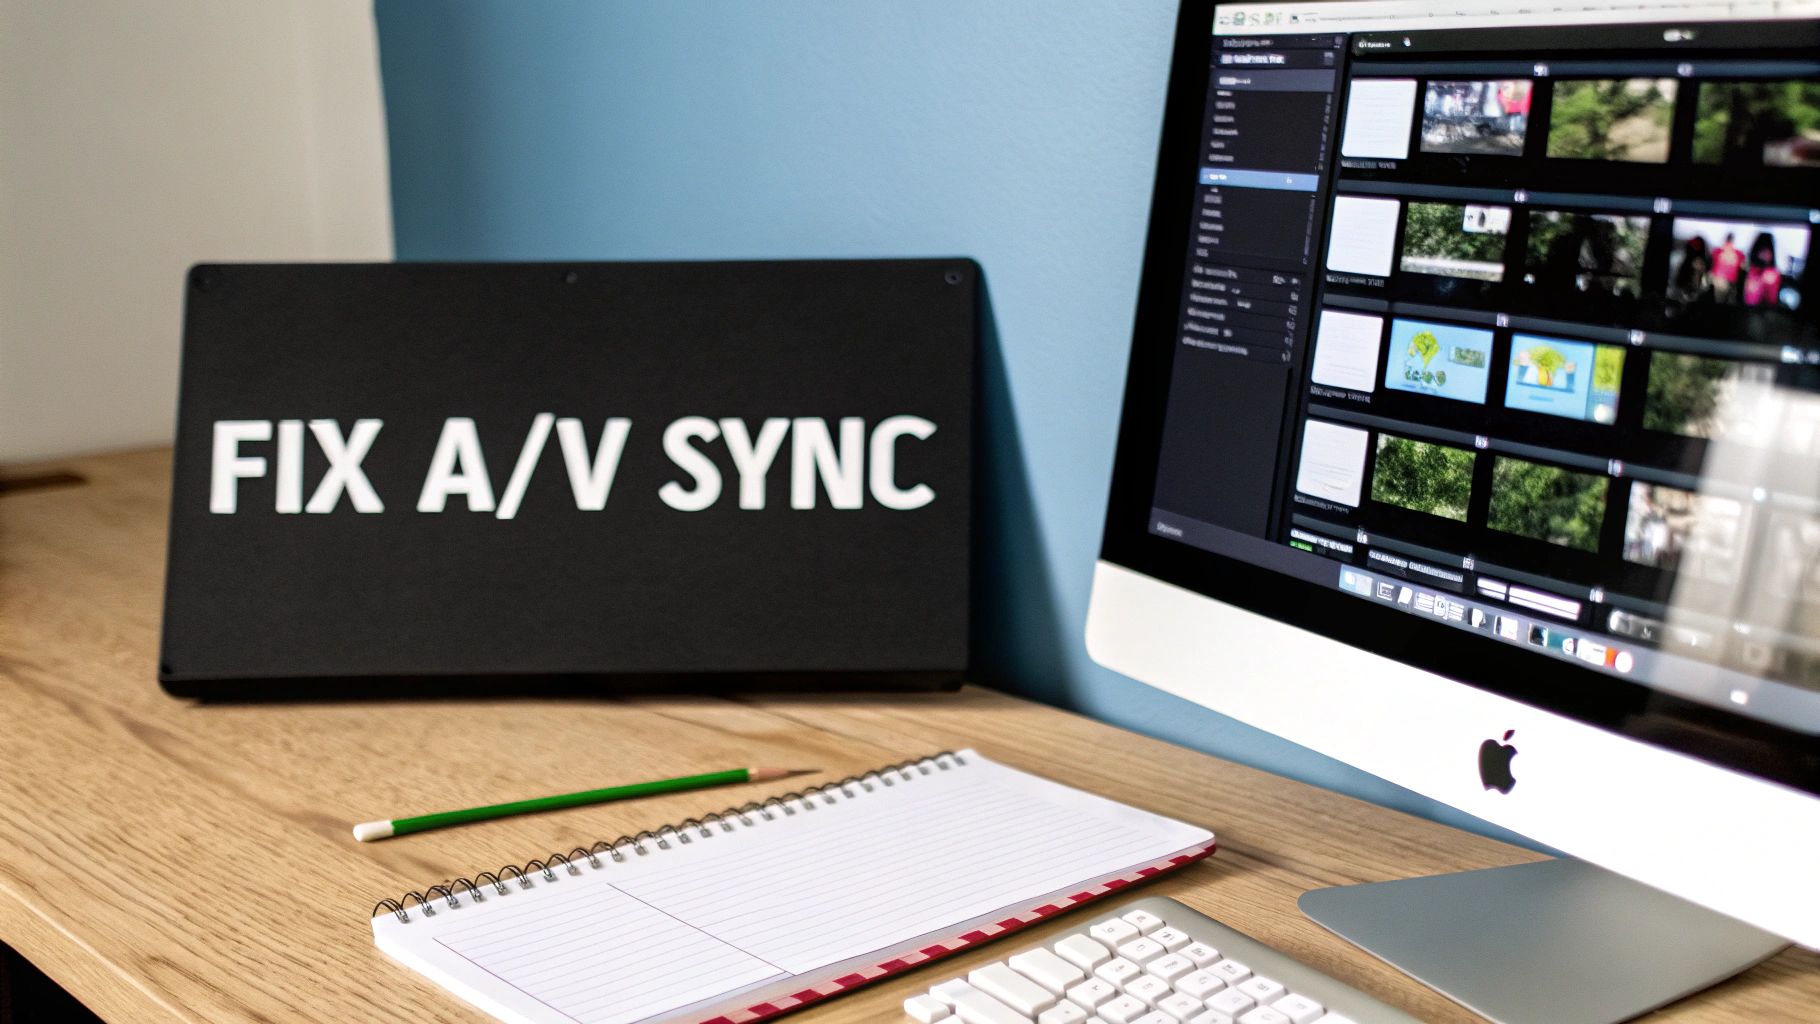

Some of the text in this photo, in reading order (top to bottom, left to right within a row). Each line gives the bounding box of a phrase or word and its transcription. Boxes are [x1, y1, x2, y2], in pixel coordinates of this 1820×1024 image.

[209, 412, 937, 520] FIX A/V SYNC
